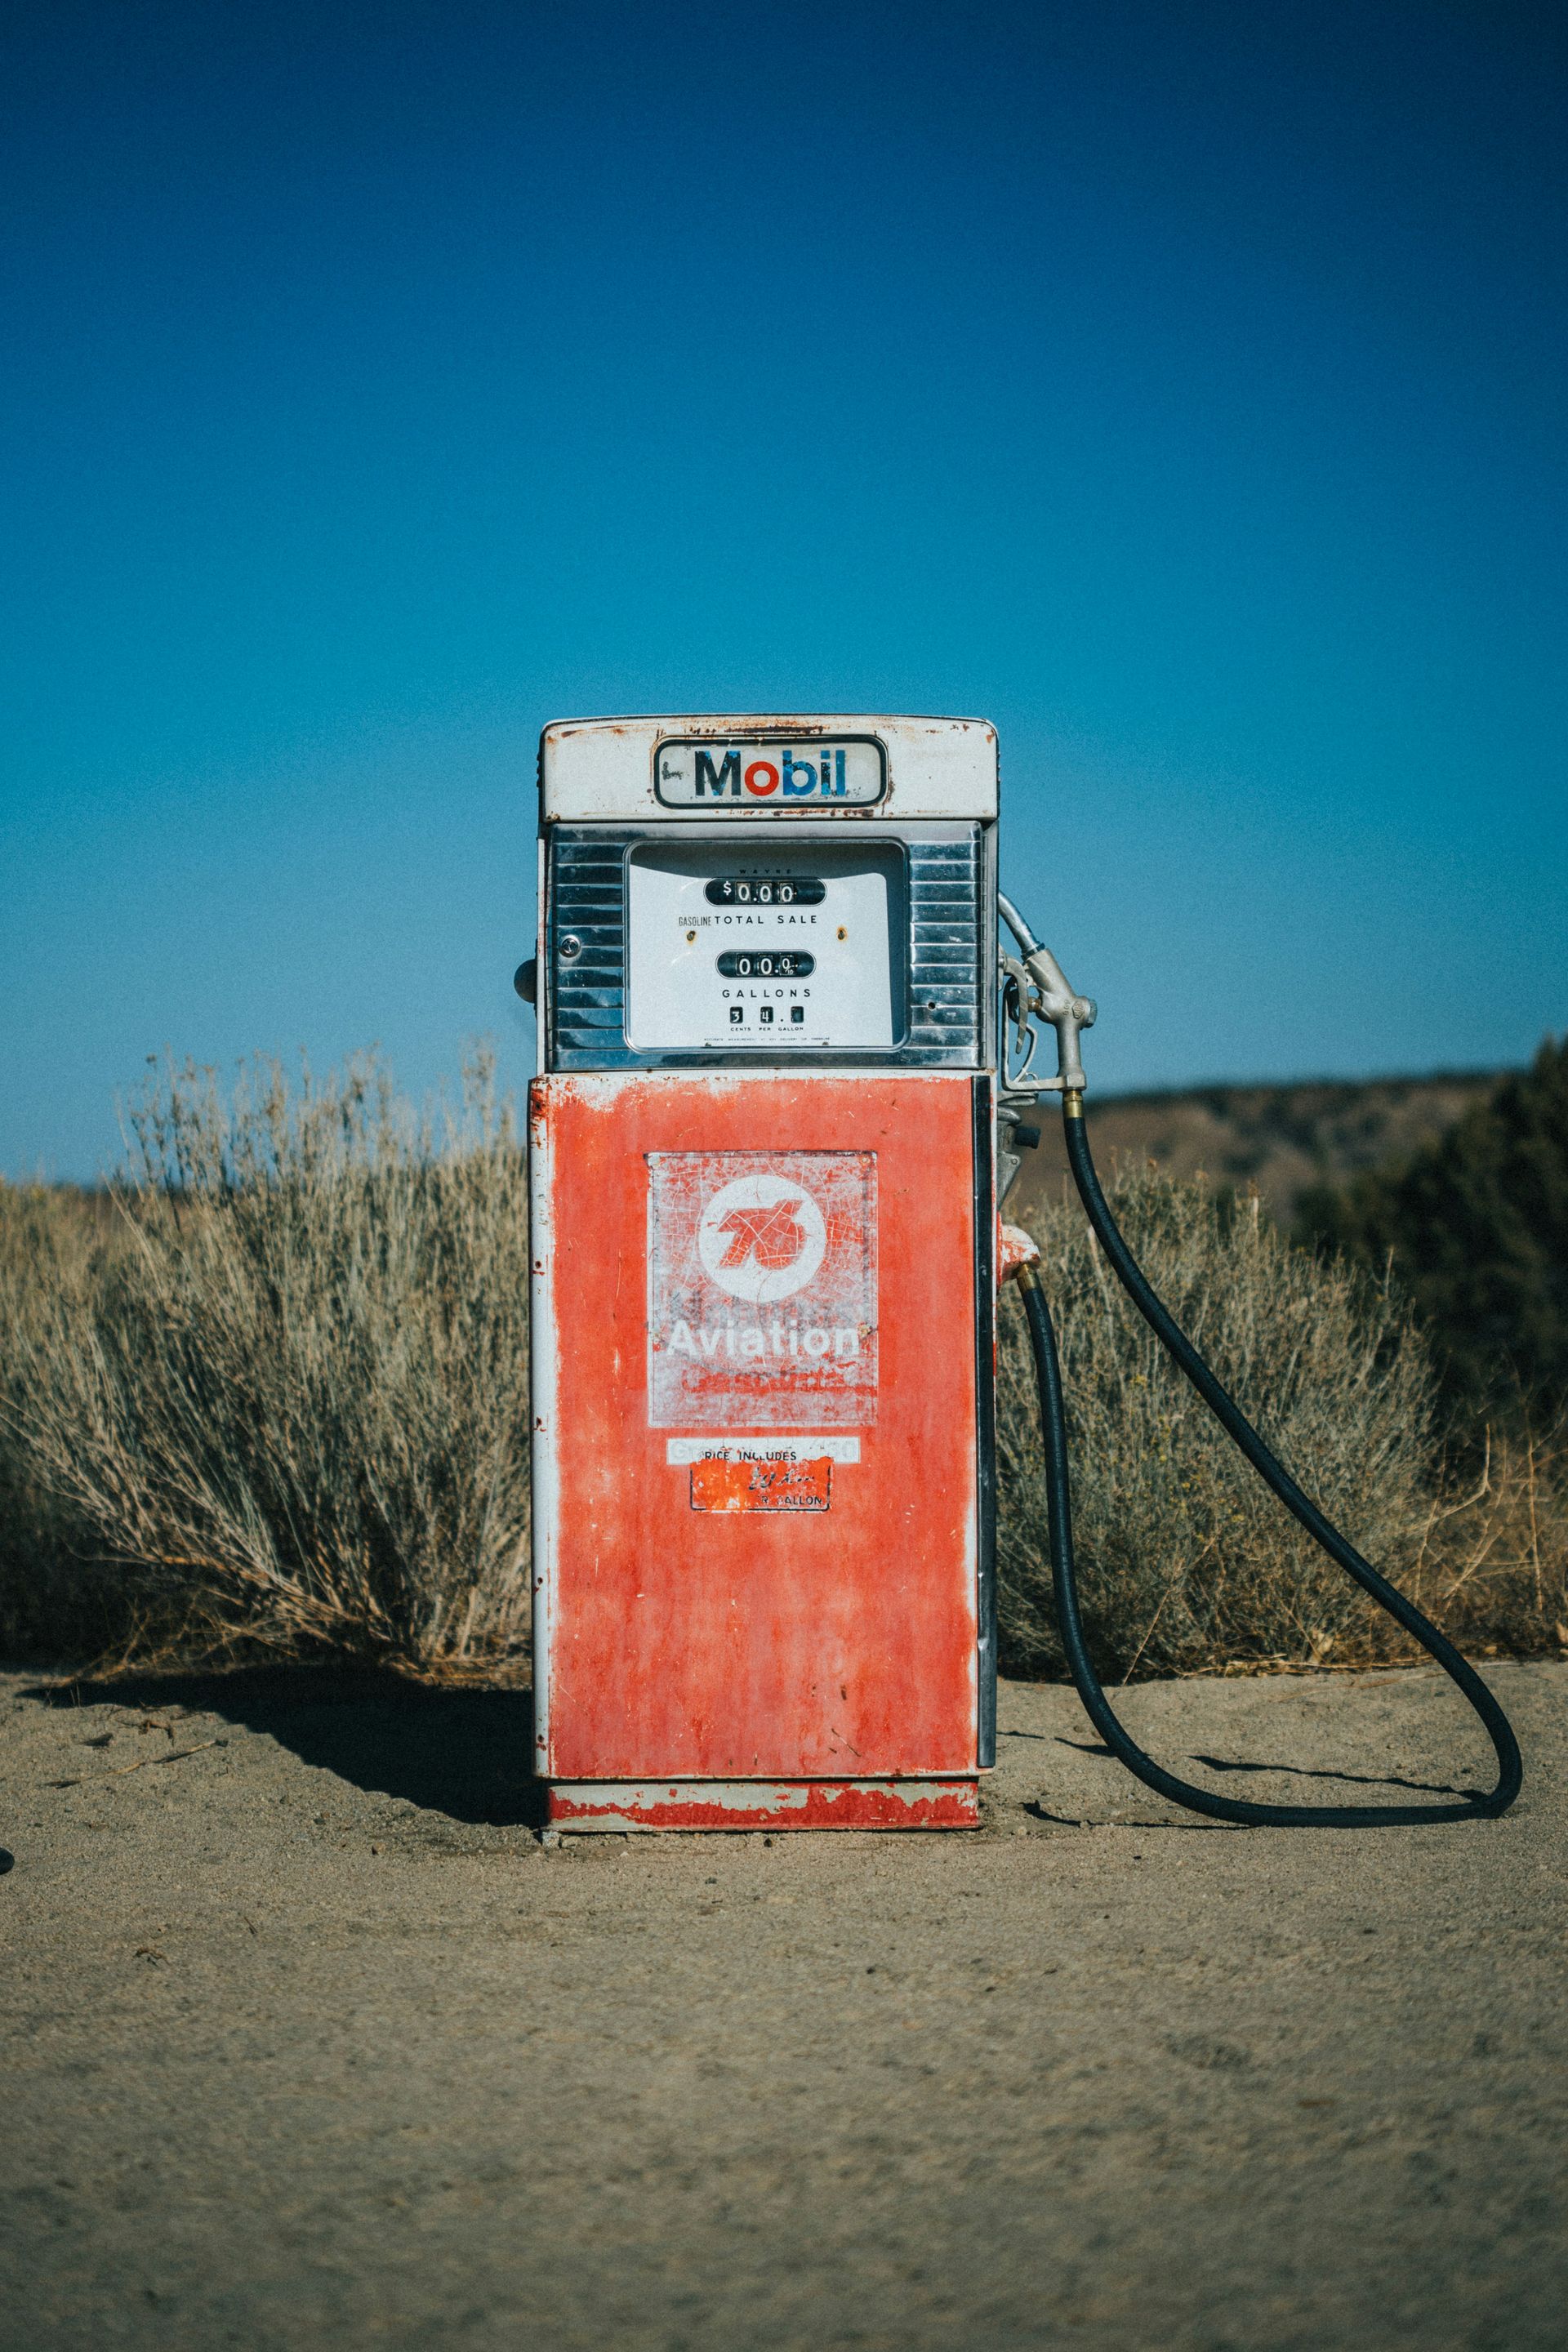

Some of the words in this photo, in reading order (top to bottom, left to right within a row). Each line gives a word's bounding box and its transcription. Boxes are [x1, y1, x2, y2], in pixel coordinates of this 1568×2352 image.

[695, 750, 846, 797] Mobil
[679, 915, 712, 927] GASOLINE
[715, 915, 764, 924] TOTAL
[777, 915, 817, 924] SALE
[722, 988, 811, 999] GALLONS
[666, 1319, 859, 1356] Aviation
[703, 1450, 730, 1461] RICE
